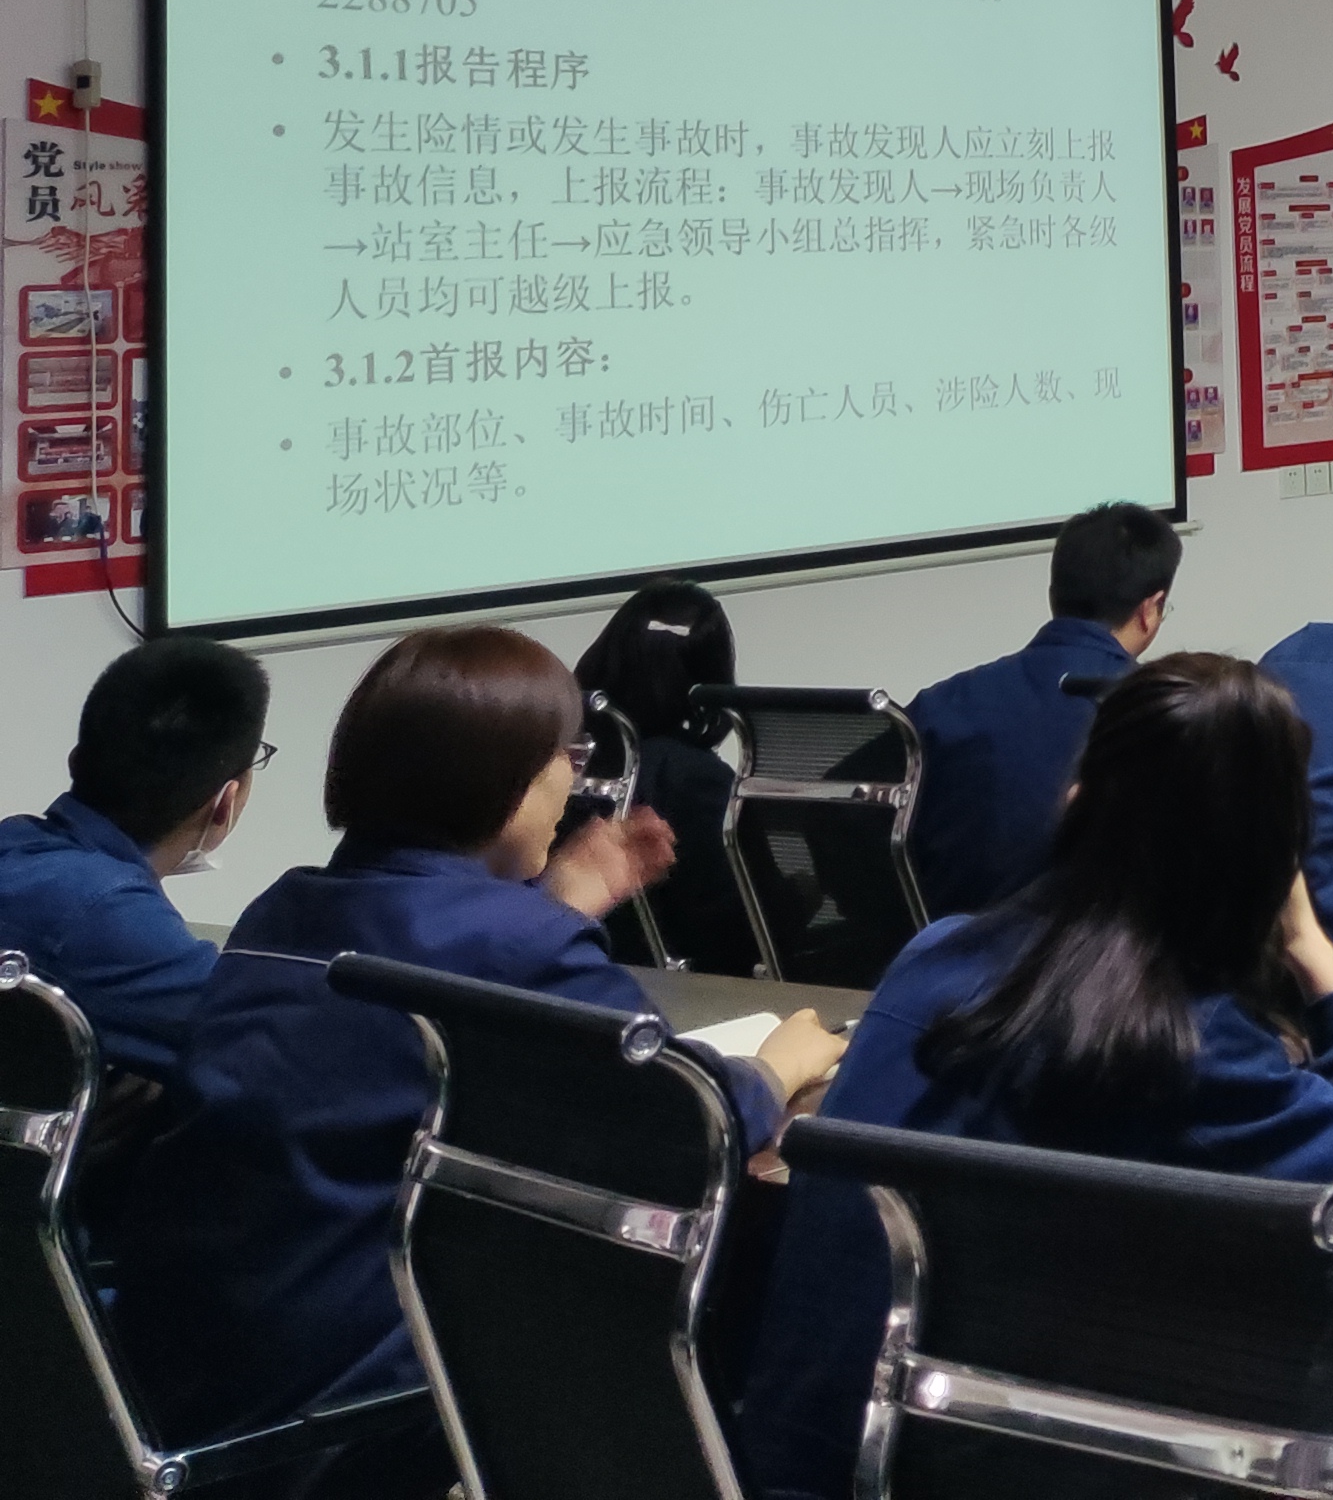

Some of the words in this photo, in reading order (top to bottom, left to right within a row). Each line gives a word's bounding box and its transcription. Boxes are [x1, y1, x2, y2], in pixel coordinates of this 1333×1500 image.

[317, 43, 591, 92] 3.1.1报告程序
[23, 141, 65, 223] 党员
[1236, 177, 1255, 293] 发展党员流程
[328, 271, 692, 321] 人员均可越级上报。
[325, 460, 527, 517] 场状况等。
